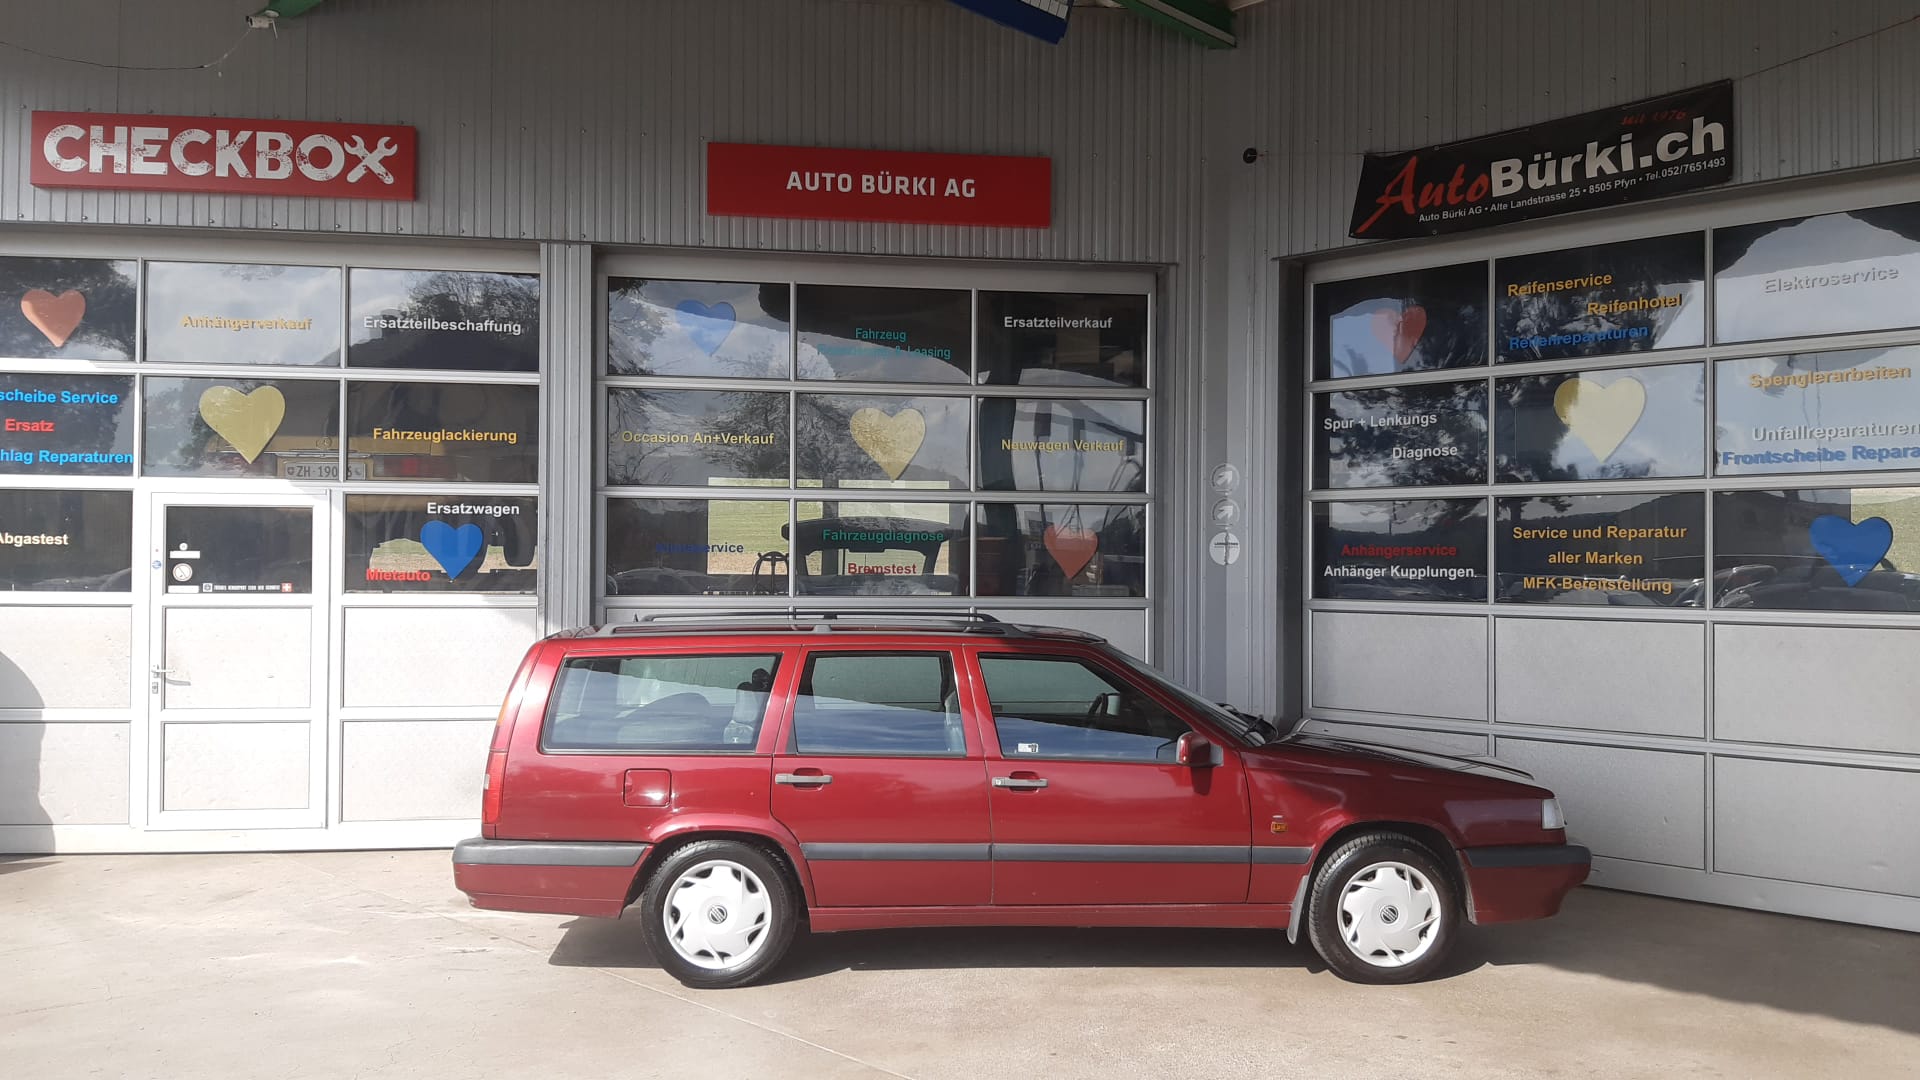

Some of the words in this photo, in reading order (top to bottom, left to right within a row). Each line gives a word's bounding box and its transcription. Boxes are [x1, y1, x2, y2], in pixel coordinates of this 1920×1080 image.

[42, 123, 399, 184] CHECKBOX
[786, 171, 852, 192] AUTO
[861, 171, 935, 196] BÜRKI
[944, 179, 976, 198] AG
[1418, 212, 1440, 223] Auto
[1442, 208, 1466, 220] Bürki
[1468, 206, 1482, 215] AG
[1490, 203, 1508, 212] Alte
[1511, 192, 1567, 209] Landstrasse
[1569, 188, 1581, 198] 25
[1589, 183, 1612, 194] 8505
[1614, 177, 1637, 190] Pfyn
[1507, 274, 1613, 297] Reifenservice
[1764, 267, 1900, 294] Elektroservice
[1587, 293, 1682, 315] Reifenhotel
[363, 315, 522, 335] Ersatzteilbeschaffung
[1003, 316, 1113, 330] Ersatzteilverkauf
[855, 327, 907, 343] Fahrzeug
[1509, 326, 1648, 350] Reifenreparaturen
[907, 345, 951, 360] Leasing
[1751, 366, 1911, 389] Spenglerarbeiten
[61, 390, 118, 404] Service
[5, 418, 55, 432] Ersatz
[1324, 418, 1354, 432] Spur
[1358, 417, 1367, 427] +
[1370, 414, 1437, 428] Lenkungs
[373, 428, 517, 444] Fahrzeuglackierung
[622, 430, 689, 443] Occasion
[692, 431, 775, 445] An+Verkauf
[1752, 422, 1920, 441] Unfallreparaturen
[1001, 439, 1070, 452] Neuwagen
[1073, 439, 1124, 451] Verkauf
[1392, 446, 1458, 460] Diagnose
[38, 449, 134, 466] Reparaturen
[1723, 447, 1846, 466] Frontscheibe
[296, 466, 311, 478] ZH
[427, 502, 520, 517] Ersatzwagen
[822, 529, 945, 544] Fahrzeugdiagnose
[1512, 526, 1568, 539] Service
[1572, 527, 1602, 539] und
[1606, 525, 1688, 540] Reparatur
[1341, 543, 1457, 560] Anhängerservice
[1548, 551, 1581, 564] aller
[1585, 551, 1643, 565] Marken
[365, 567, 431, 582] Mietauto
[847, 562, 917, 575] Bremstest
[1324, 565, 1386, 580] Anhänger
[1523, 577, 1673, 595] MFK-Bereitstellung
